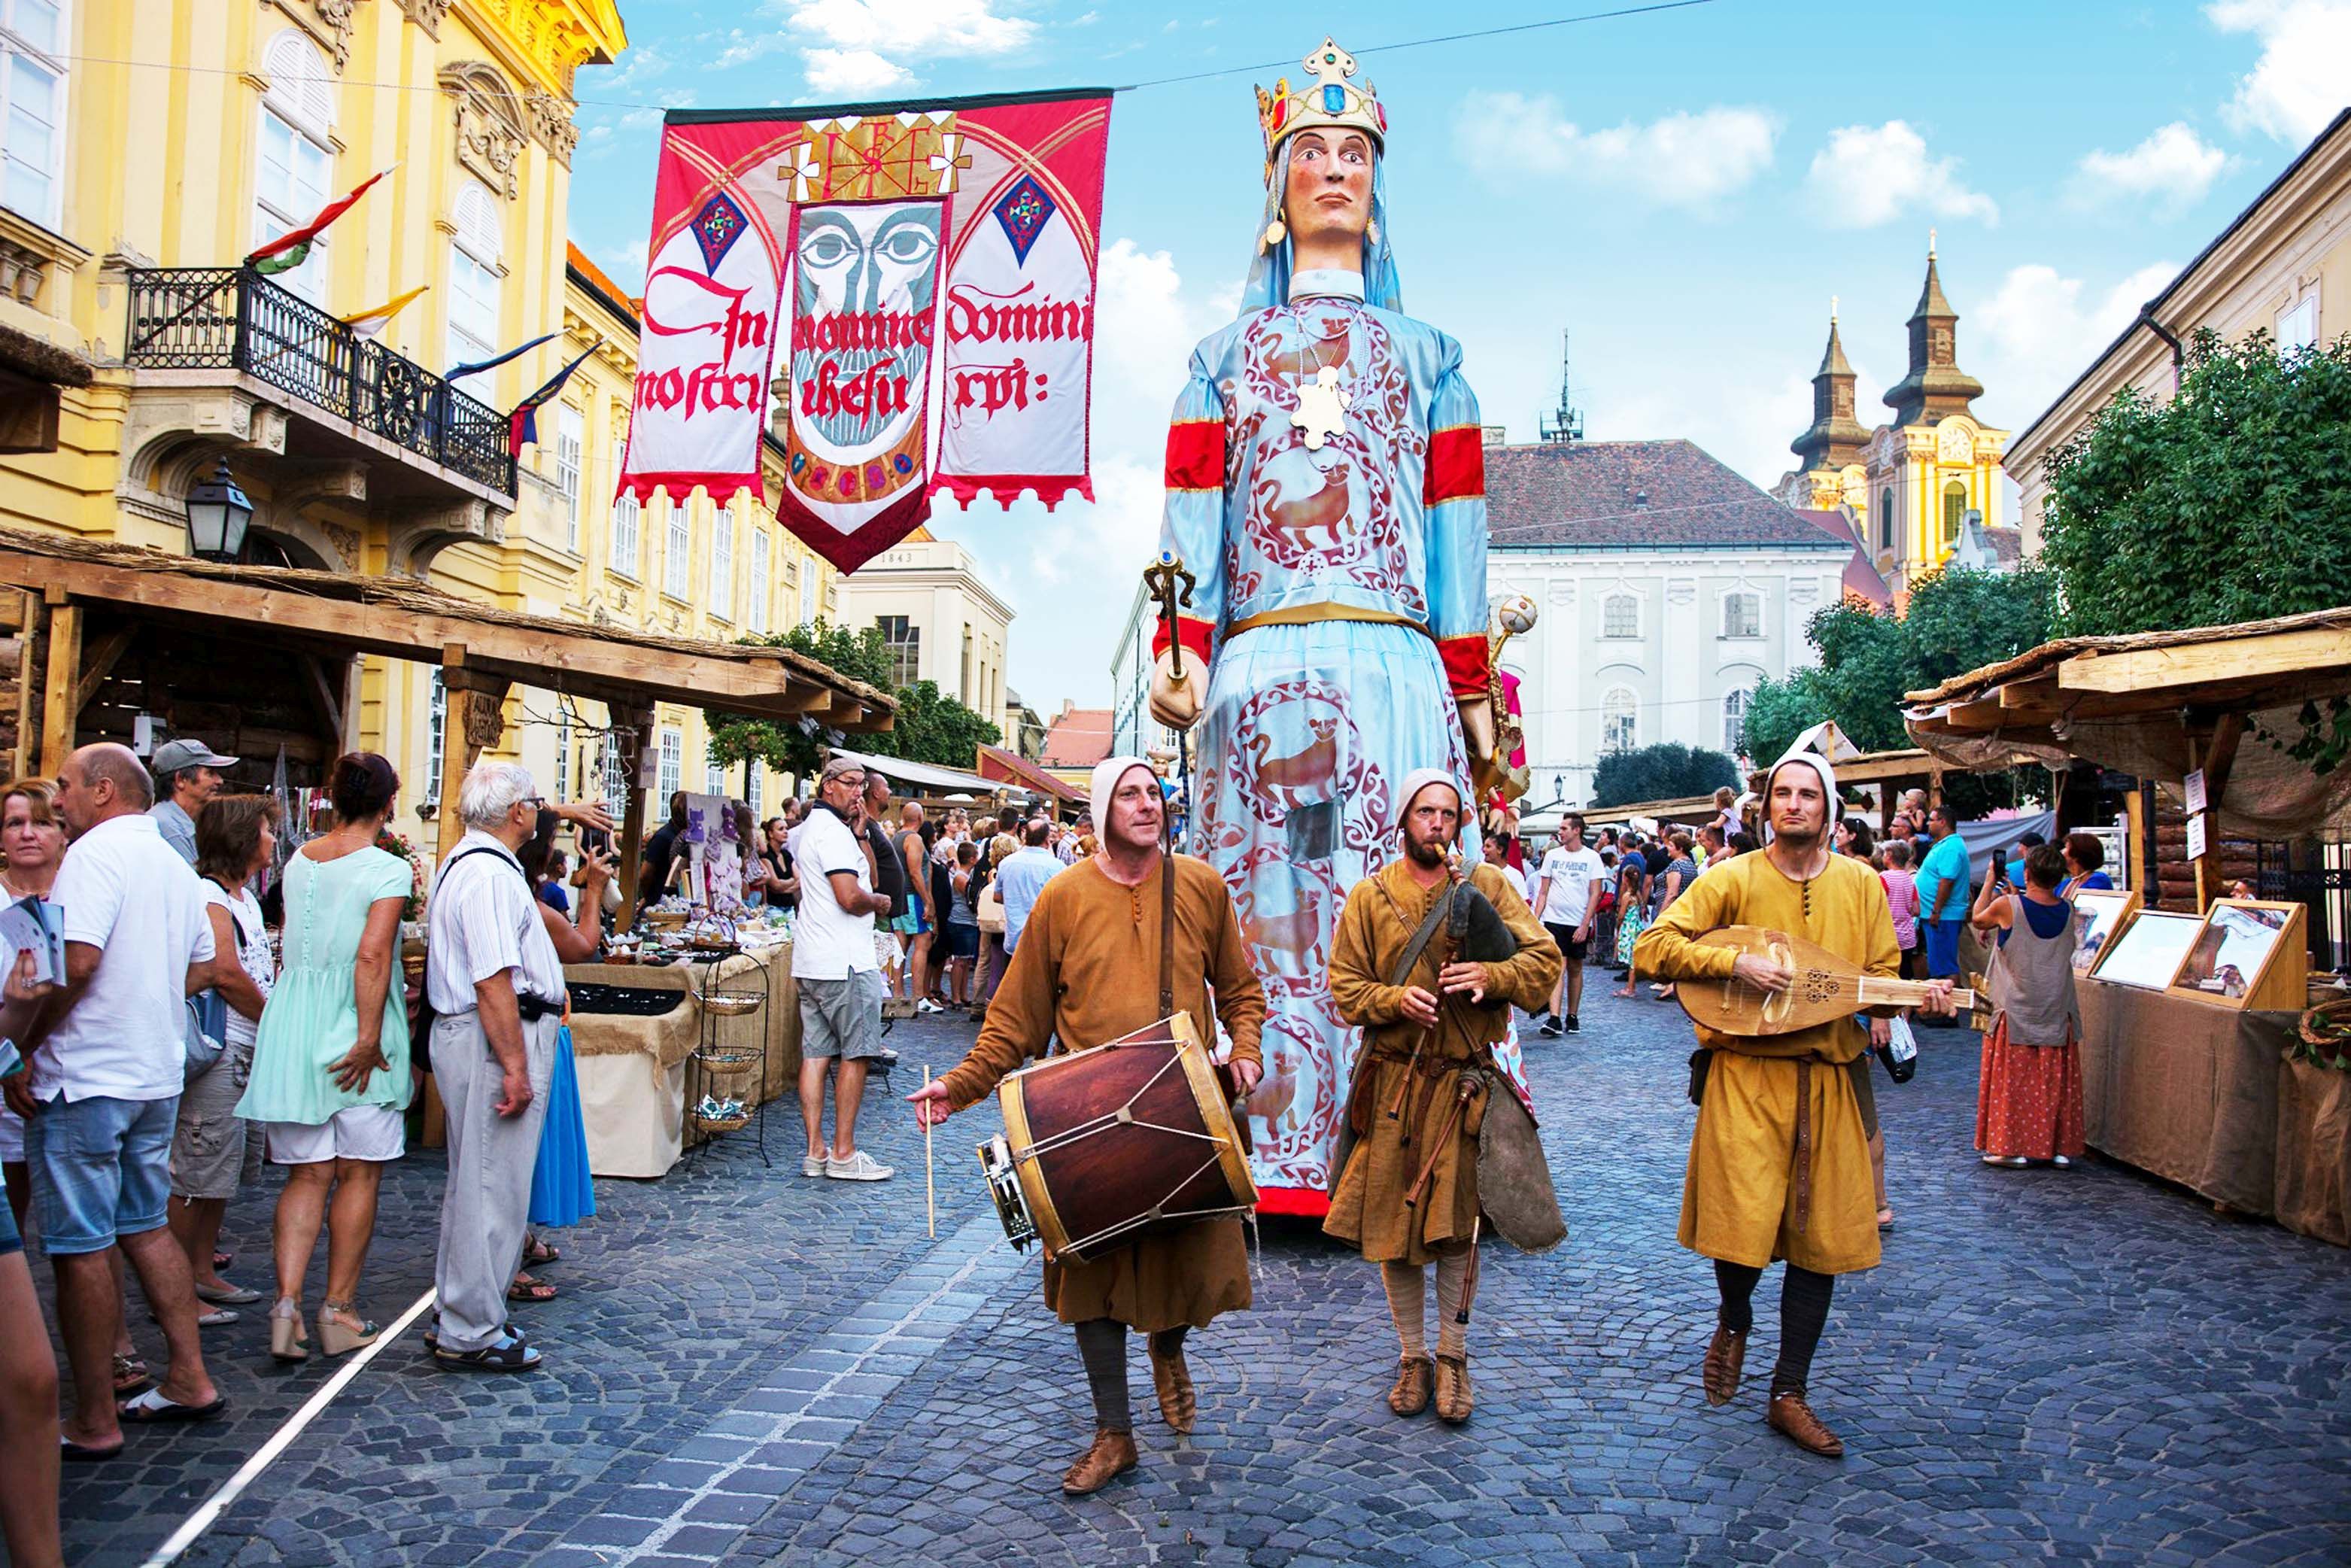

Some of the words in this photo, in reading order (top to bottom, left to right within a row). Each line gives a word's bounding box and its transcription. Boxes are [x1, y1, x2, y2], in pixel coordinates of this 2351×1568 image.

[643, 265, 769, 375] In
[791, 299, 934, 360] nomine
[881, 552, 913, 563] 1843
